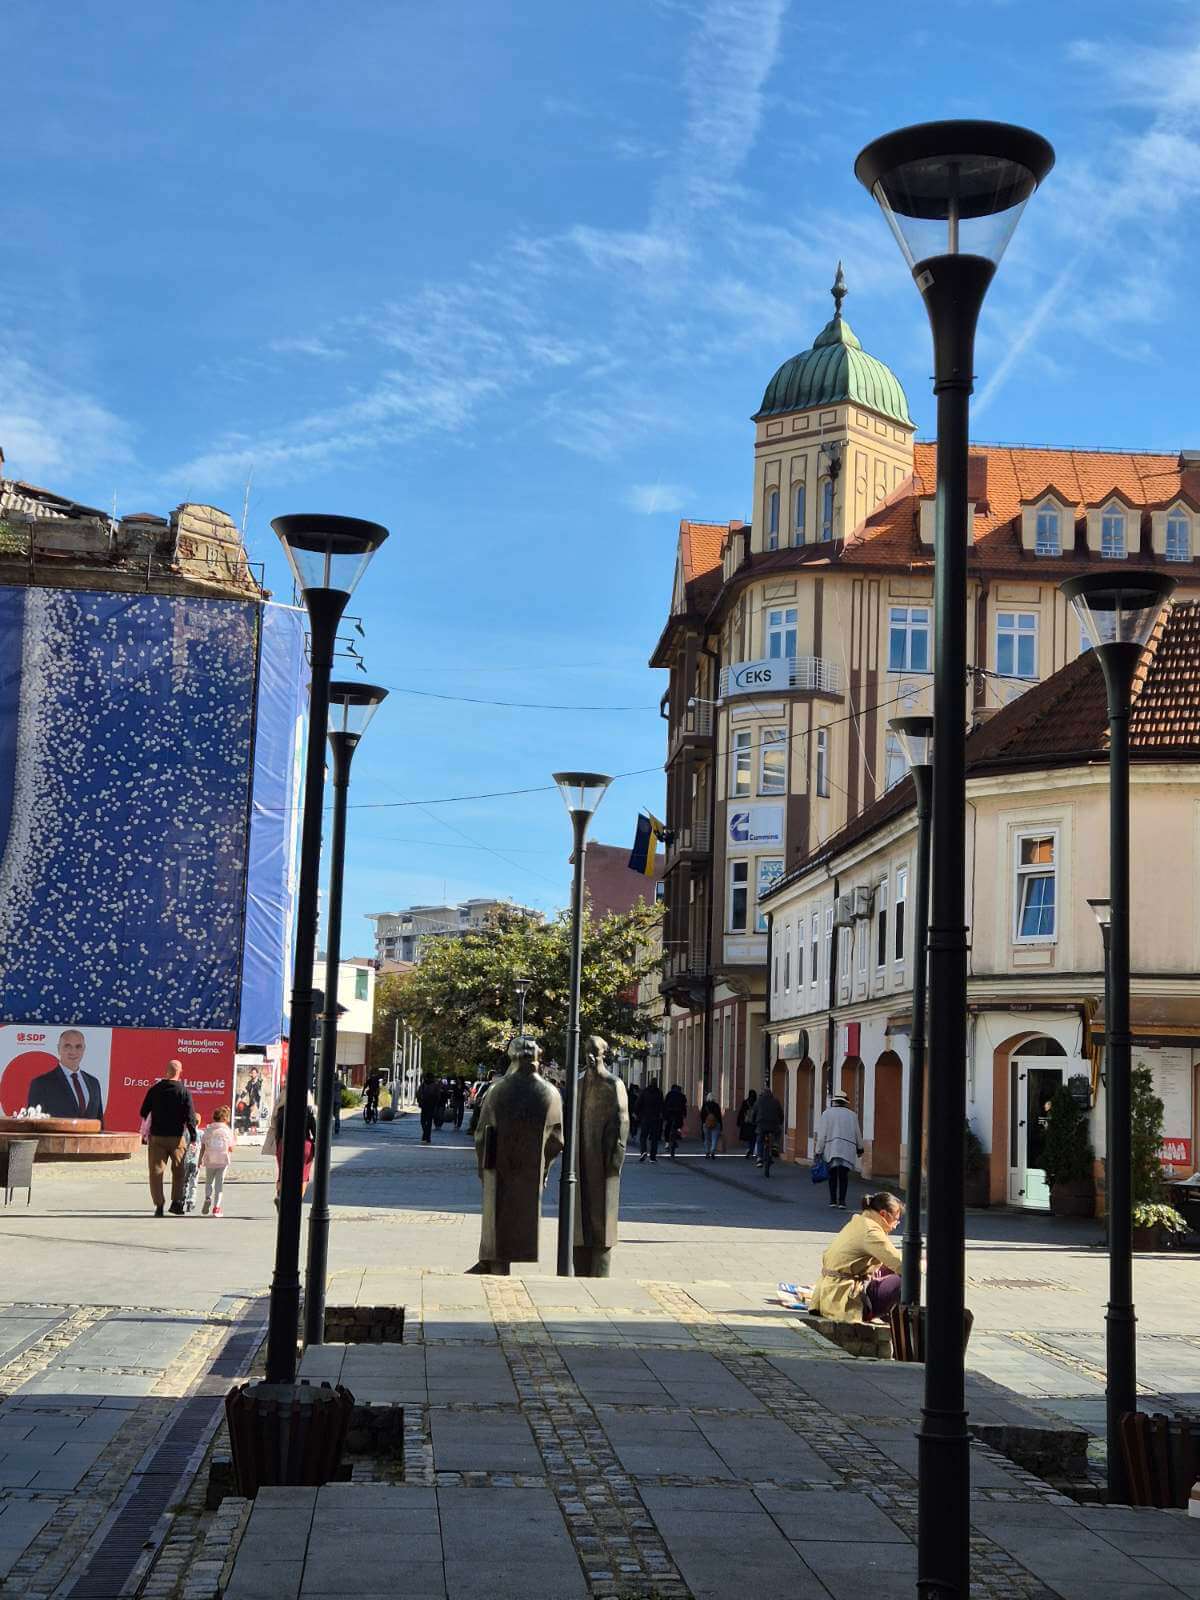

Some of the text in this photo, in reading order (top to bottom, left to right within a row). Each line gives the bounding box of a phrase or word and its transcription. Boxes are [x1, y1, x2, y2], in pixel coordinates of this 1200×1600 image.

[746, 669, 772, 684] EKS
[26, 1033, 46, 1041] SDP
[177, 1038, 224, 1047] Nastavljamo
[183, 1078, 225, 1090] Lugavić
